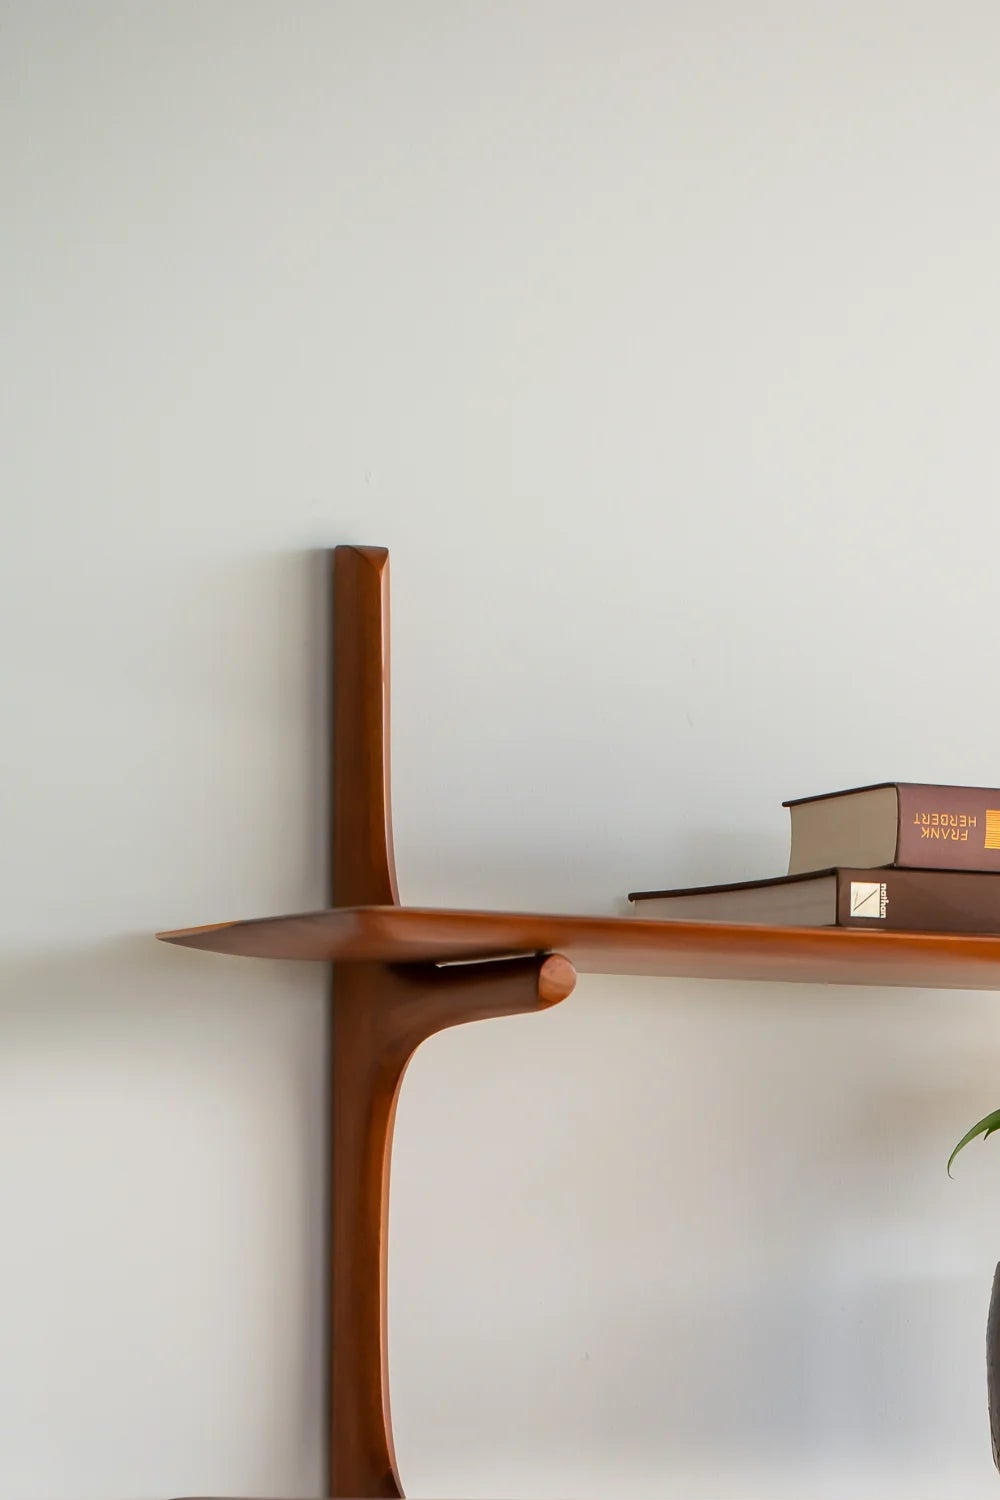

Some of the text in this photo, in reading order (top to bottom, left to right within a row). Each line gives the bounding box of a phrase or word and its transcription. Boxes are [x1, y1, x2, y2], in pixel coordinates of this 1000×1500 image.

[913, 812, 977, 828] HERBERT
[921, 827, 969, 841] FRANK
[880, 883, 889, 919] nathan
